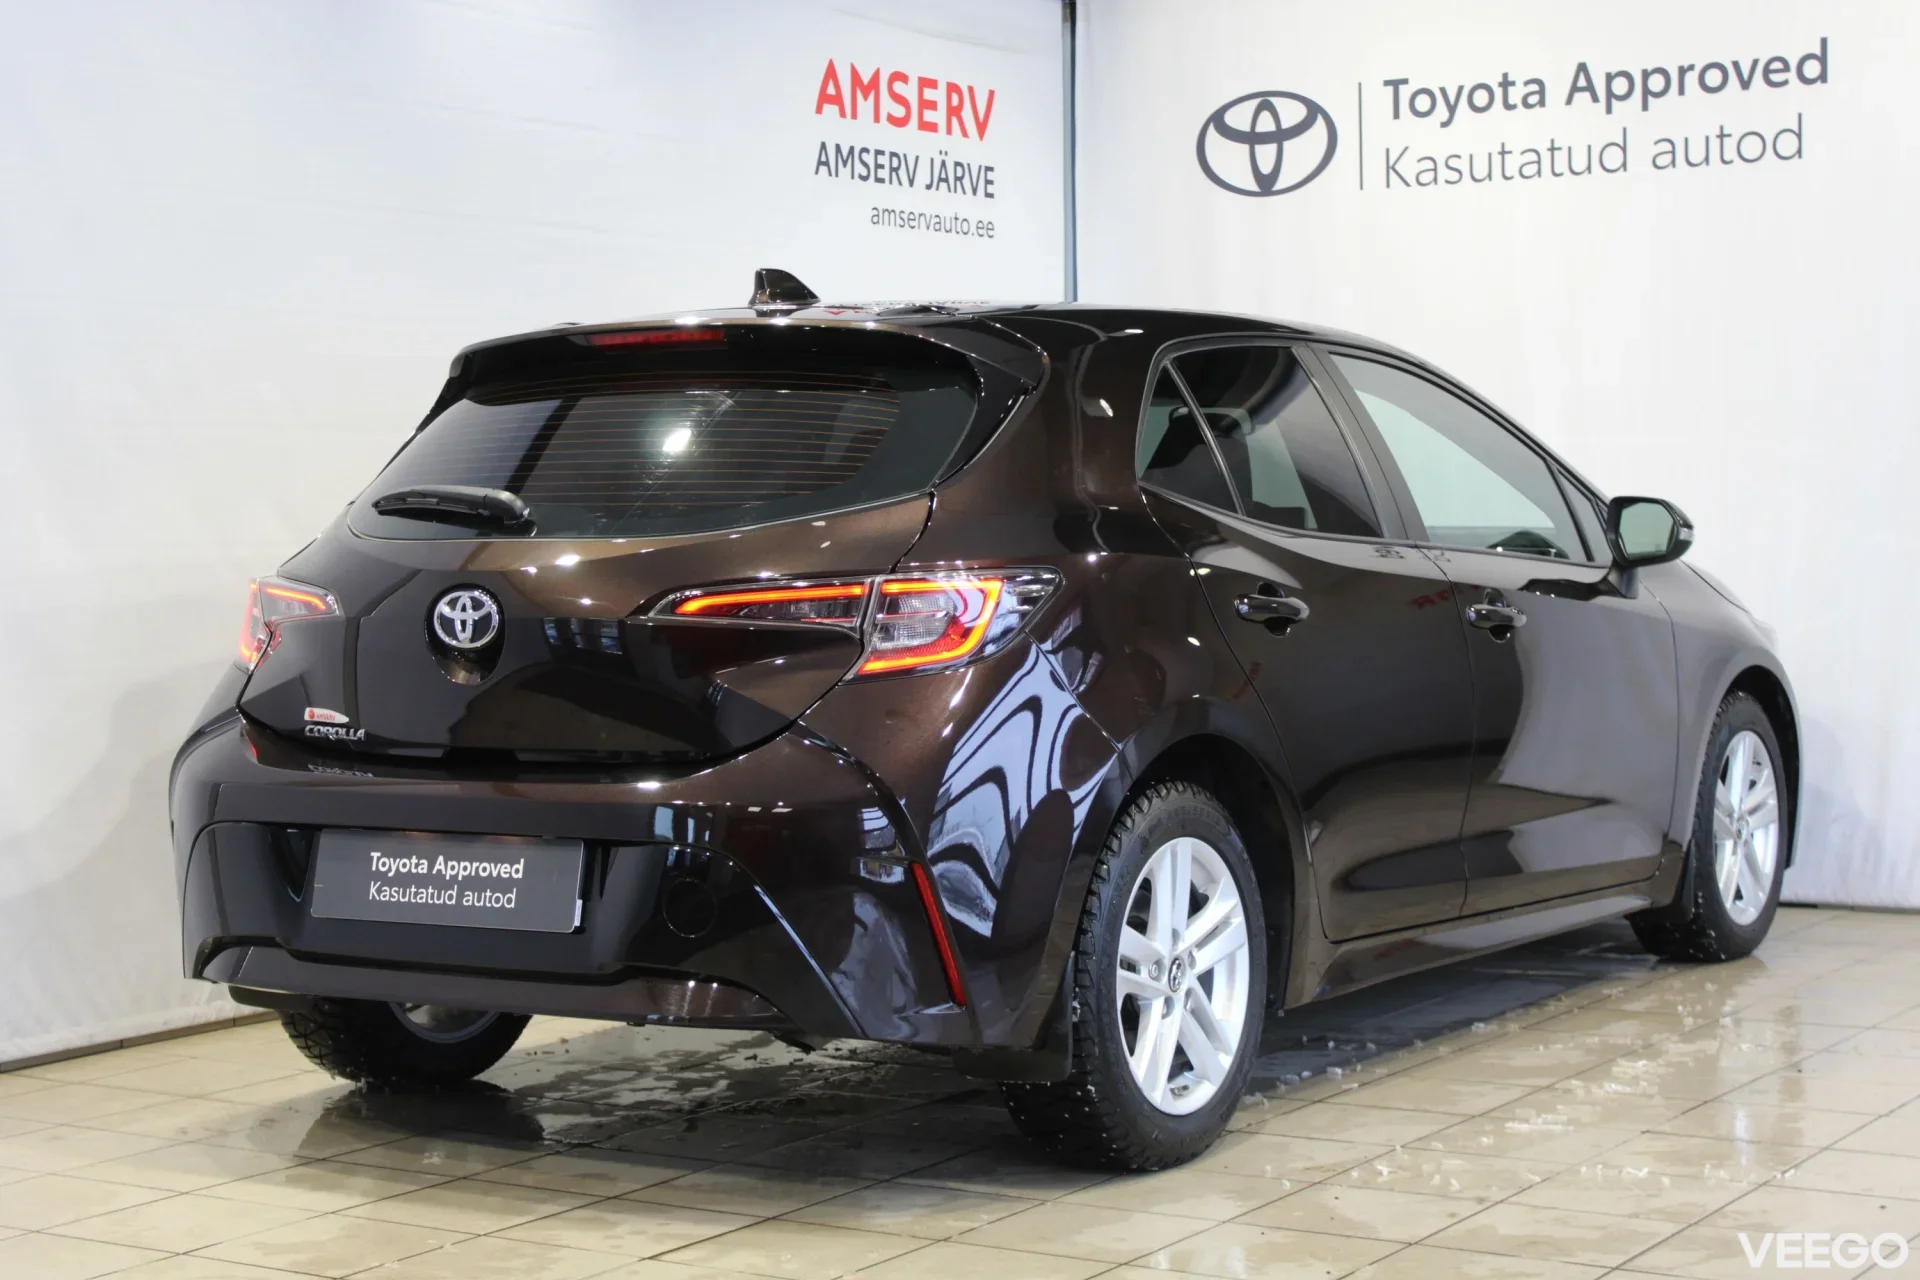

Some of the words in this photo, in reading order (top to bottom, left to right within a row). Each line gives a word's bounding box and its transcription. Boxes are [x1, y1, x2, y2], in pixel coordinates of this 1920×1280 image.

[815, 57, 996, 142] AMSERV
[1383, 71, 1547, 128] Toyota
[1564, 36, 1829, 115] Approved
[814, 140, 920, 189] AMSERV
[924, 149, 995, 200] JÄRVE
[1384, 126, 1629, 189] Kasutatud
[1651, 112, 1804, 169] autod
[870, 205, 996, 239] amservauto.ee
[304, 724, 366, 741] COROLLA
[370, 851, 428, 877] Toyota
[432, 855, 525, 881] Approved
[368, 880, 458, 906] Kasutatud
[462, 887, 517, 909] autod
